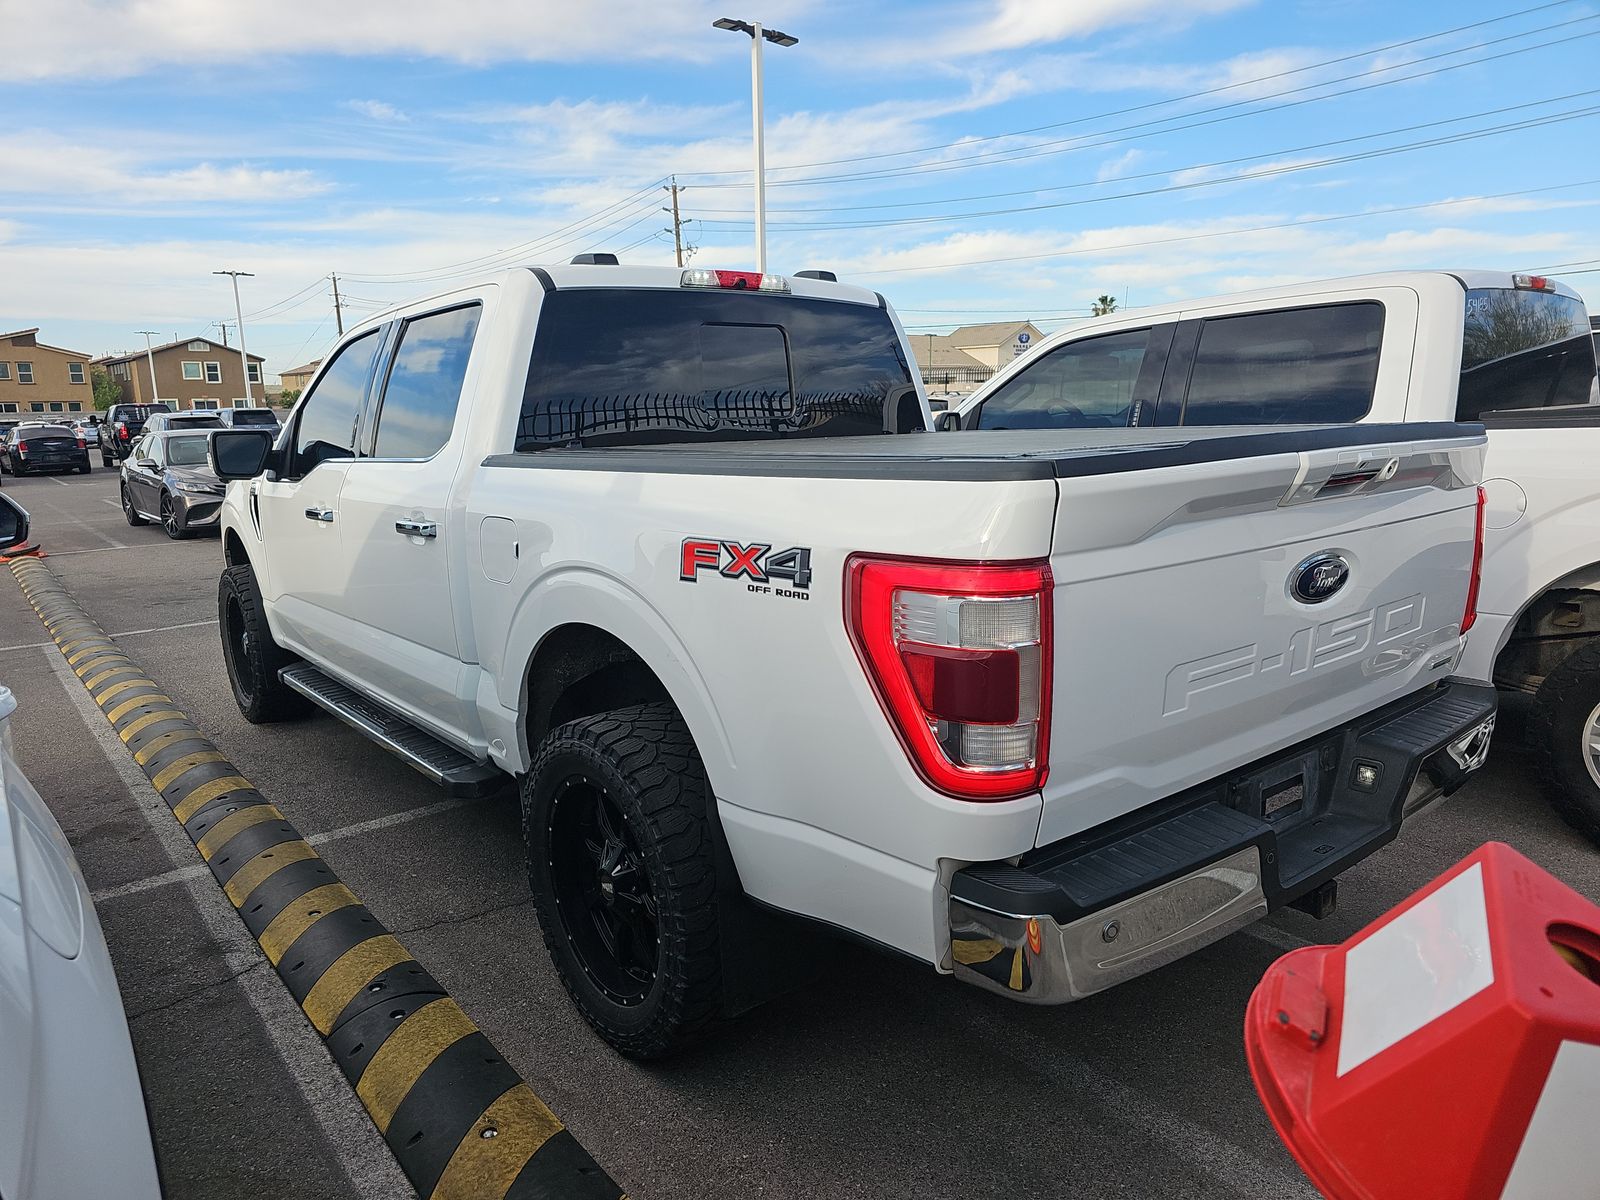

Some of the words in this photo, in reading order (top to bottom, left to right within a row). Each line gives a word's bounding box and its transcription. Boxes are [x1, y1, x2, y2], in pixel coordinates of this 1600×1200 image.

[680, 537, 812, 589] FX4
[747, 584, 771, 594] OFF
[775, 588, 809, 600] ROAD
[1162, 592, 1426, 717] F-150
